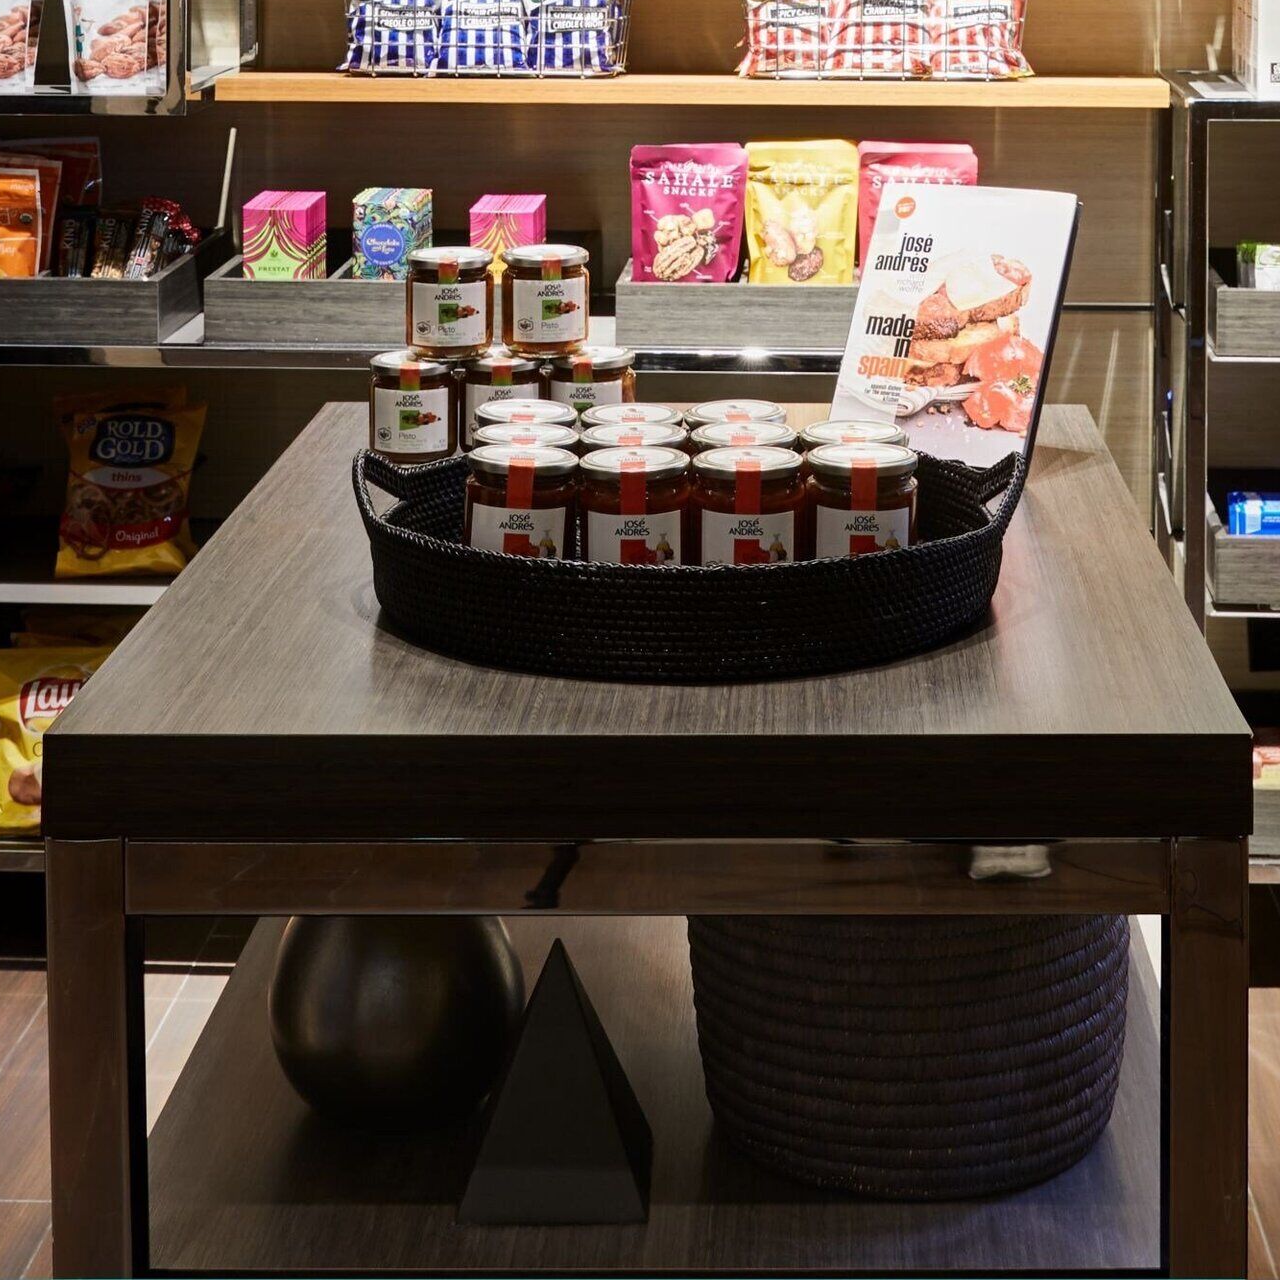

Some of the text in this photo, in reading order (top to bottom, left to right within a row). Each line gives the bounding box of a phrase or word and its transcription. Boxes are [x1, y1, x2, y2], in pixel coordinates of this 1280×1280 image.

[645, 171, 734, 188] SAHALE
[663, 187, 716, 197] SNACKS
[135, 207, 154, 235] KIND
[62, 218, 75, 249] KIND
[366, 238, 400, 247] Chocolate
[875, 252, 929, 274] andrés
[865, 314, 915, 338] made
[893, 336, 911, 358] in
[857, 356, 908, 379] spain
[108, 420, 163, 438] ROLD
[96, 436, 165, 460] GOLD
[112, 471, 143, 483] thins
[115, 526, 160, 545] Original
